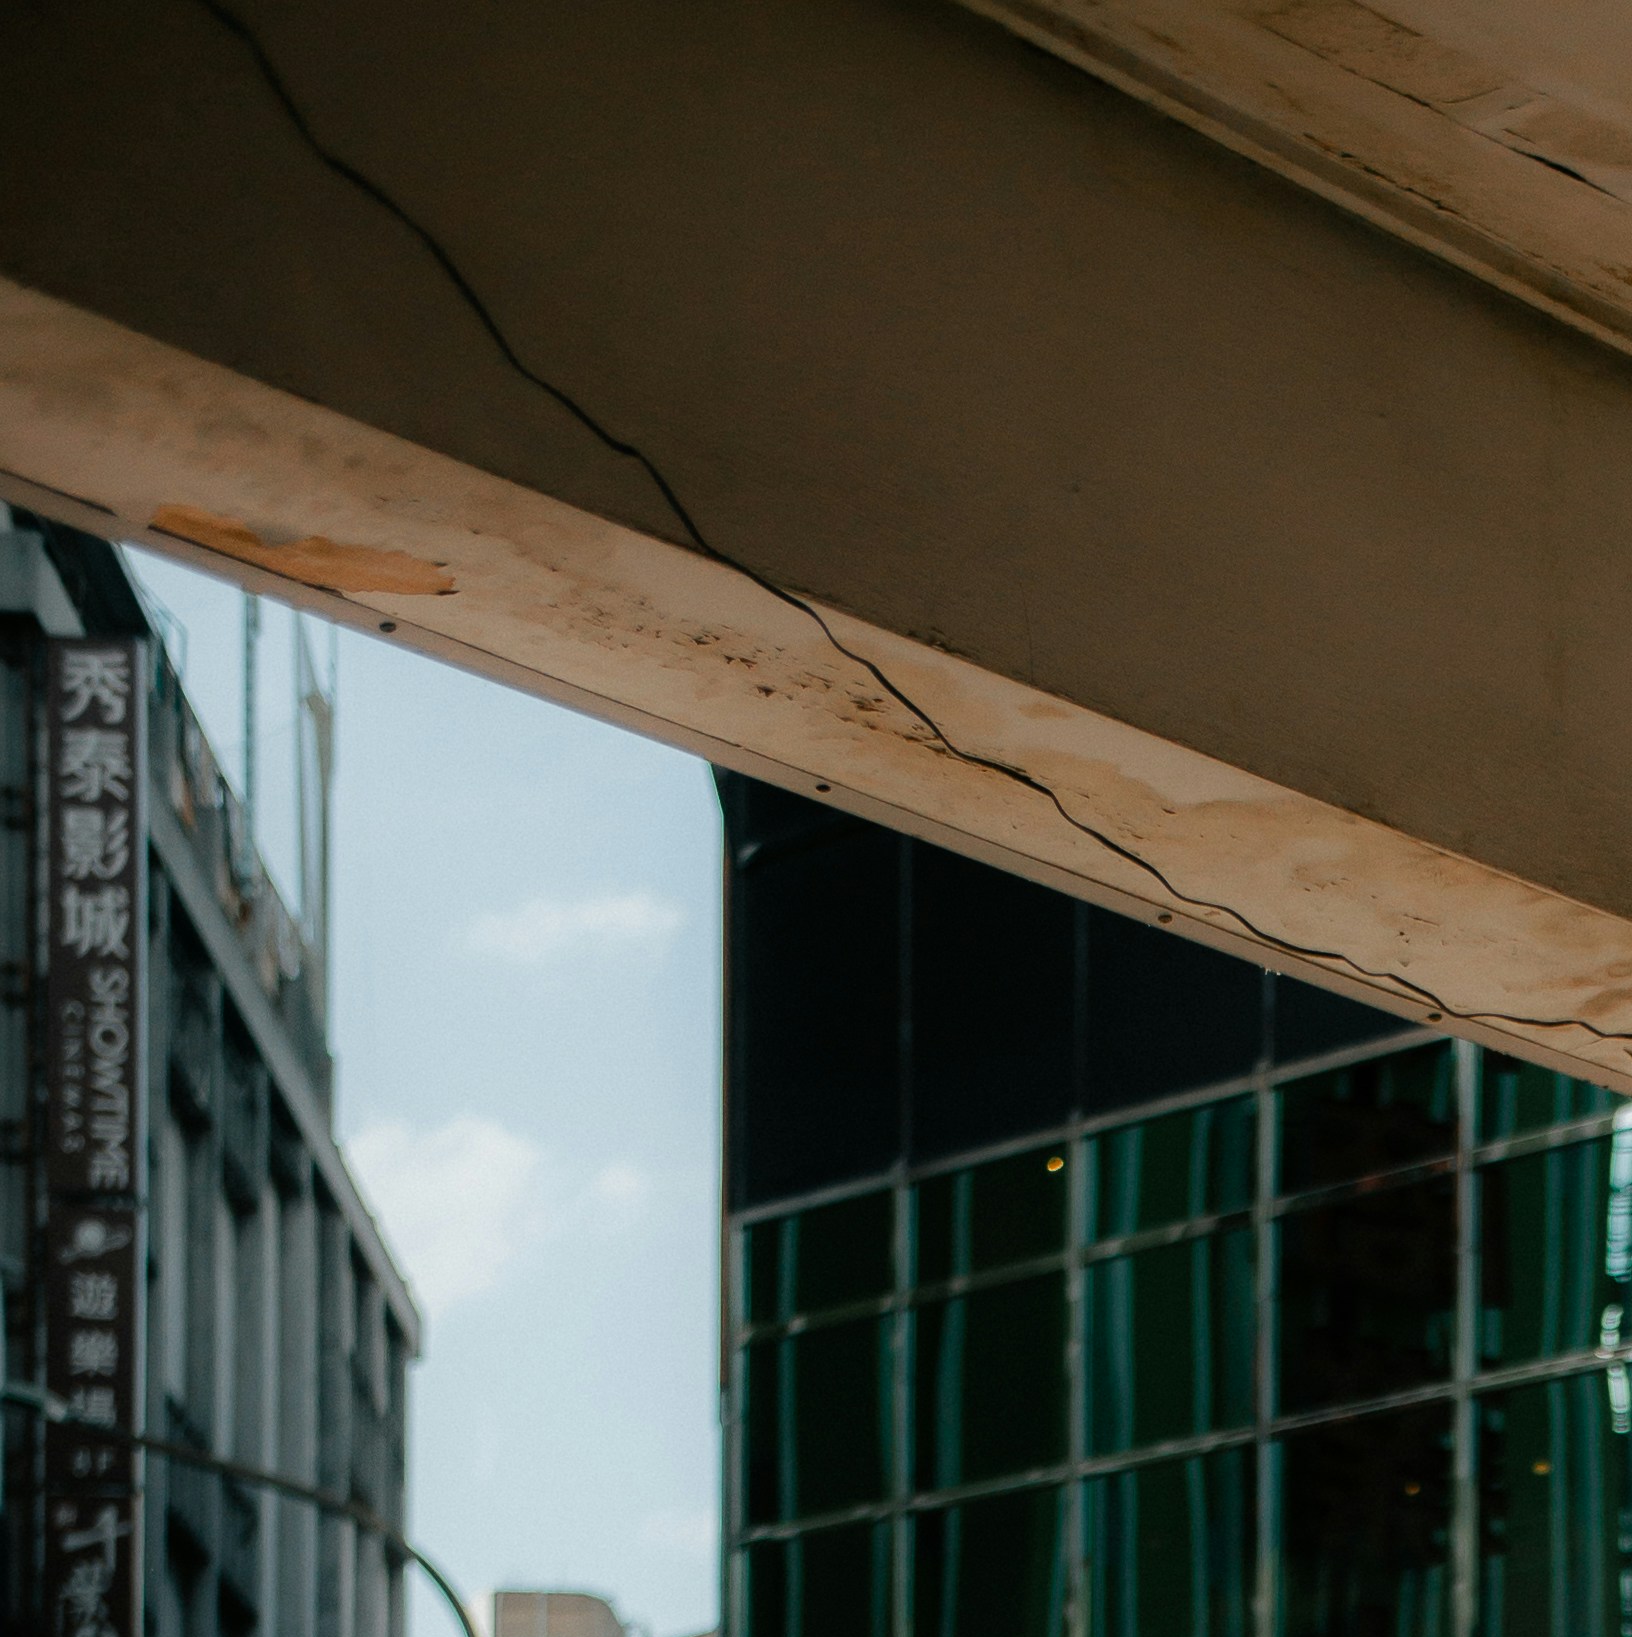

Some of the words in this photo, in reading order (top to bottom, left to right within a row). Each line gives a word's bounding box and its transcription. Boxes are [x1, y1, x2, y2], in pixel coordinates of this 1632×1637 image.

[59, 647, 133, 960] 秀泰影城
[59, 1000, 87, 1155] CINEMAS
[88, 965, 131, 1191] SHOWTIME
